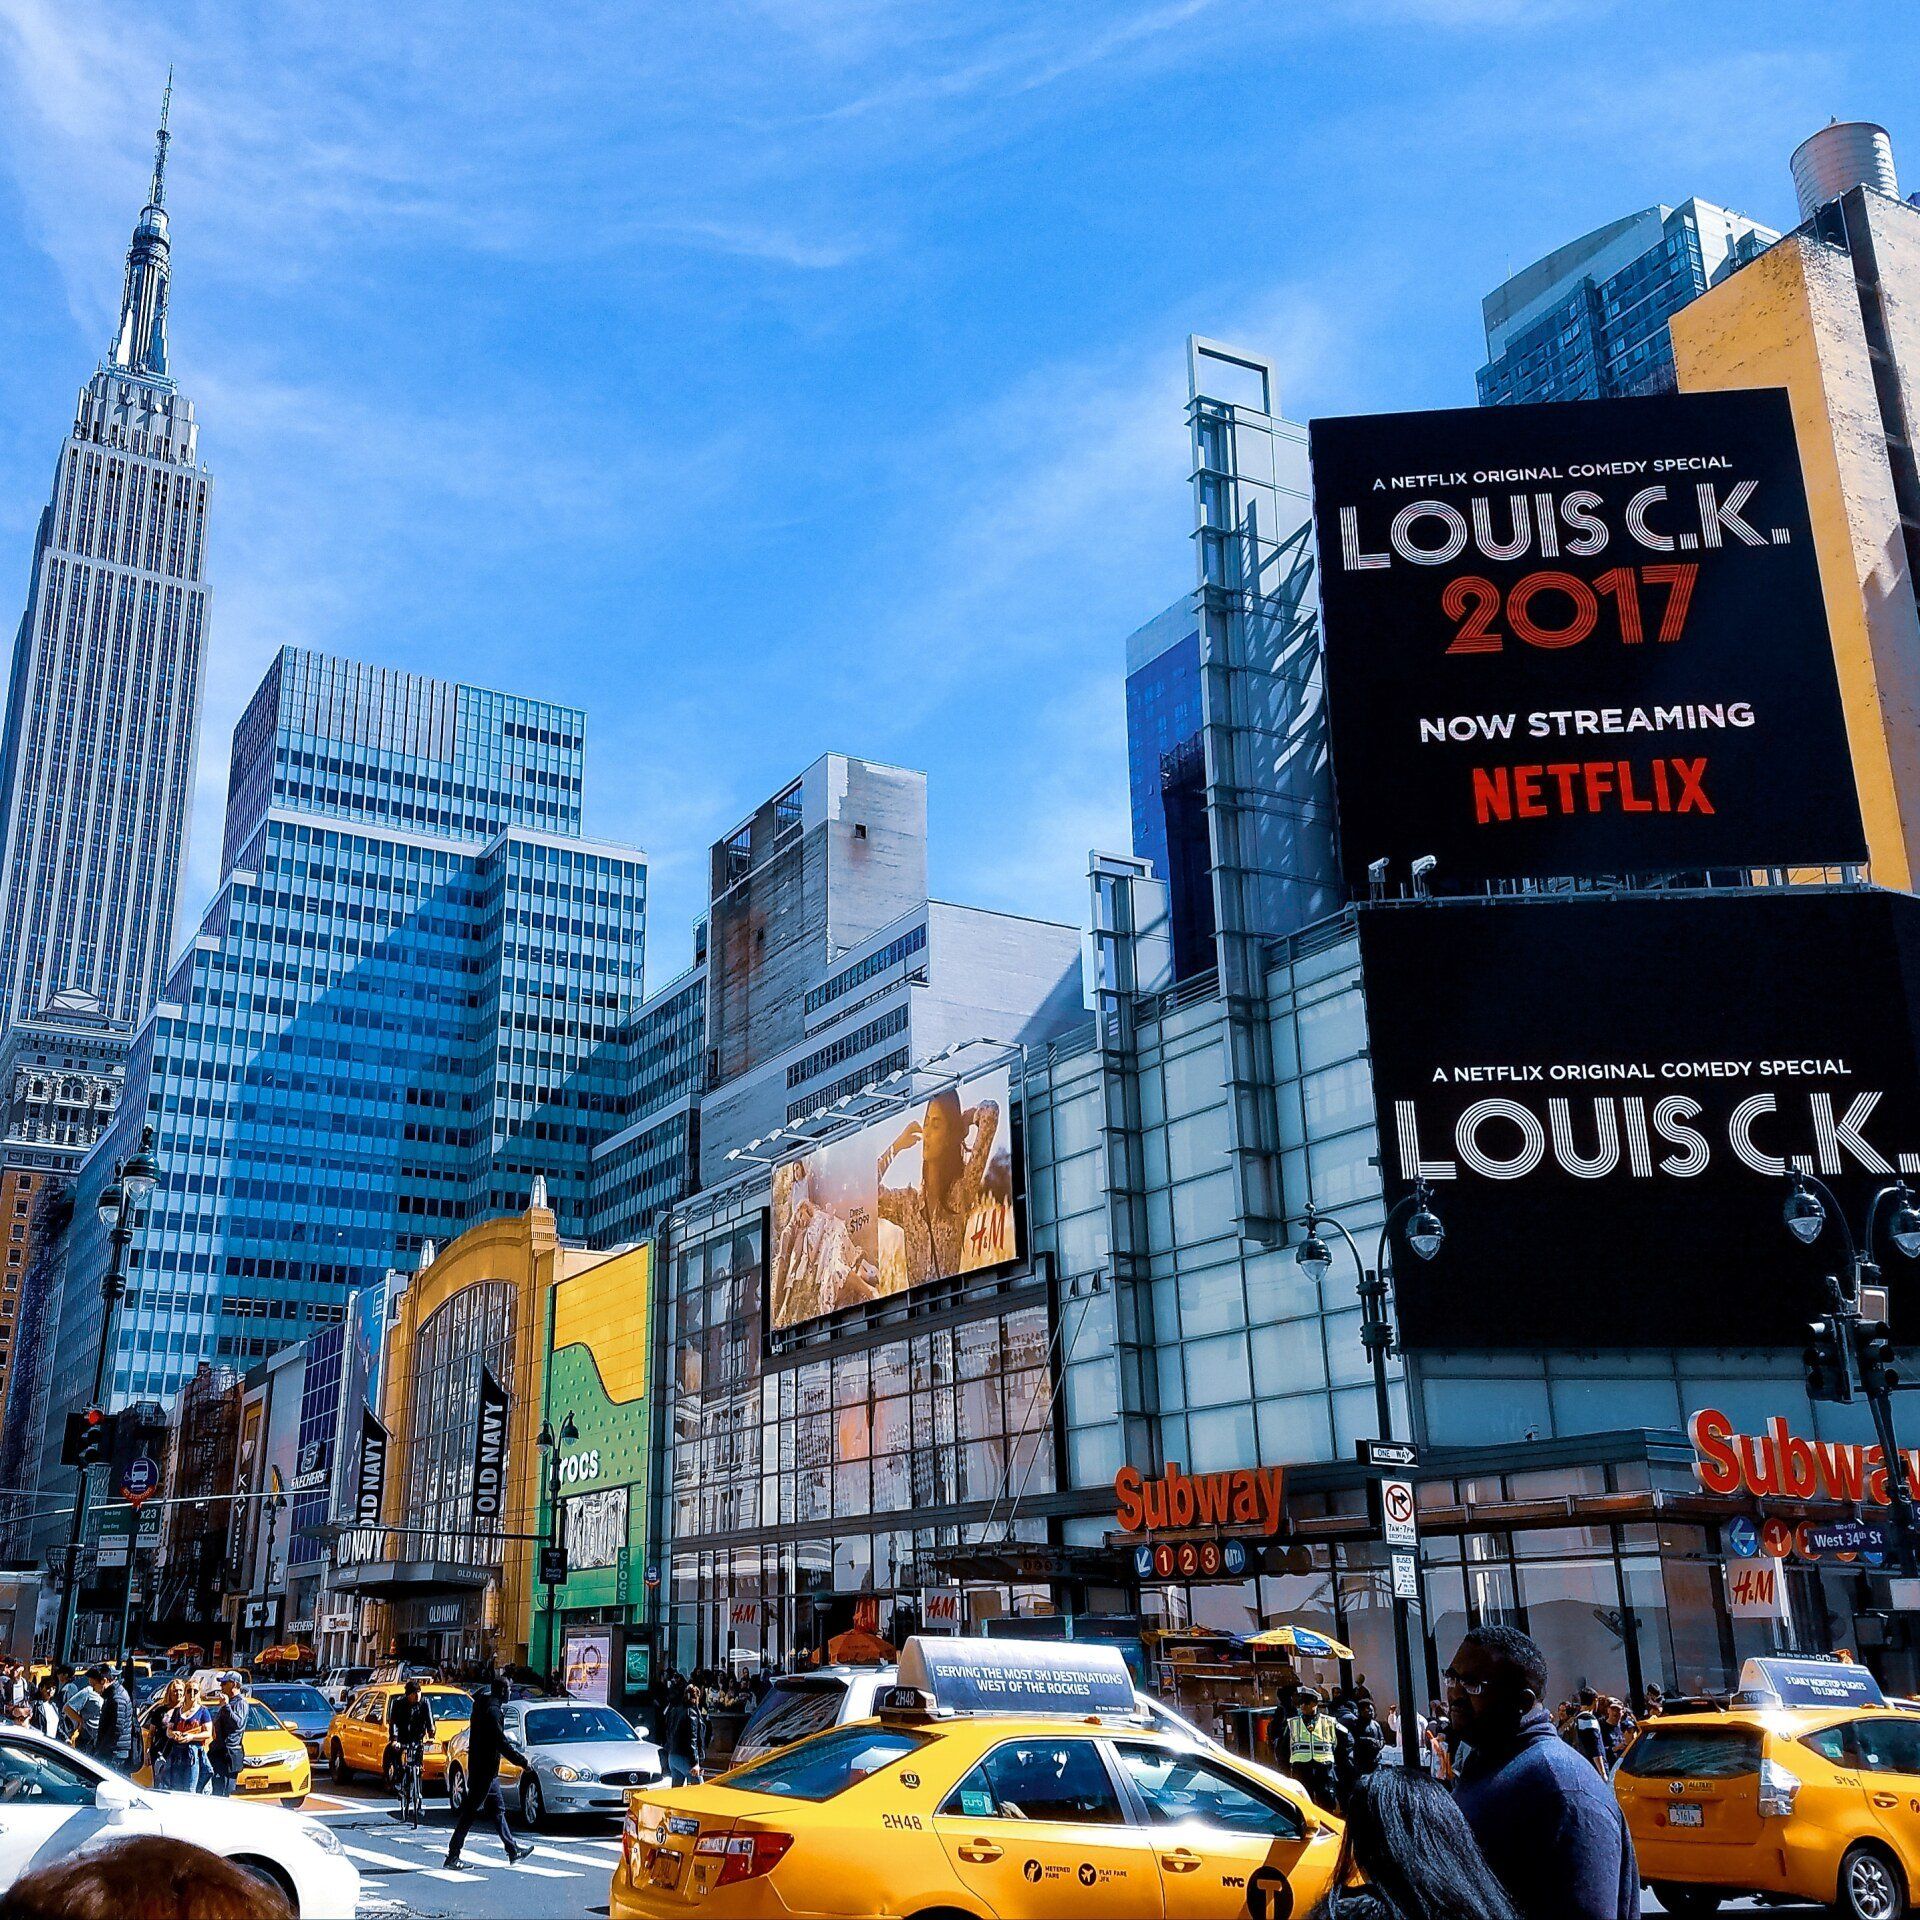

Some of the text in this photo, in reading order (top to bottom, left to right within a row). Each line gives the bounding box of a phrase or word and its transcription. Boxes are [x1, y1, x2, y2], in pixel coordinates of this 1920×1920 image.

[1372, 455, 1732, 491] A NETFLIX ORIGINAL COMEDY SPECIAL
[1339, 480, 1791, 571] LOUIS C.K.
[1441, 563, 1699, 655] 2017
[1419, 702, 1756, 743] NOW STREAMING
[1472, 757, 1716, 824] NETFLIX
[1432, 1059, 1852, 1083] A NETFLIX ORIGINAL COMEDY SPECIAL
[1395, 1091, 1920, 1180] LOUIS C.K.
[970, 1204, 1006, 1257] H&M
[363, 1438, 382, 1490] NAVY
[477, 1401, 505, 1513] OLD NAVY
[1377, 1449, 1410, 1459] ONE WAY
[236, 1473, 248, 1518] KAY
[1115, 1461, 1284, 1536] Subway
[337, 1532, 351, 1567] OLD
[351, 1530, 384, 1565] NAVY
[1771, 1526, 1782, 1551] 1
[1815, 1530, 1883, 1548] West 34th St
[1160, 1548, 1243, 1571] 1 2 3 MTA
[1396, 1556, 1411, 1564] BUSES
[1398, 1565, 1410, 1573] ONLY
[458, 1570, 492, 1580] OLD NAVY
[1732, 1569, 1774, 1606] H&M
[429, 1604, 459, 1623] OLD NAVY
[731, 1604, 757, 1624] H&M
[927, 1596, 956, 1619] H&M
[1816, 1654, 1831, 1662] curb
[936, 1665, 1122, 1685] SERVING THE MOST SKI DESTINATIONS
[1792, 1677, 1809, 1686] DAILY
[1841, 1680, 1867, 1691] FLIGHTS
[895, 1691, 915, 1707] 2H48
[977, 1680, 1090, 1695] WEST OF THE ROCKIES
[1811, 1686, 1849, 1697] TO LONDON
[1045, 1866, 1070, 1874] METERED
[1222, 1876, 1244, 1888] NYC
[1257, 1880, 1282, 1920] T
